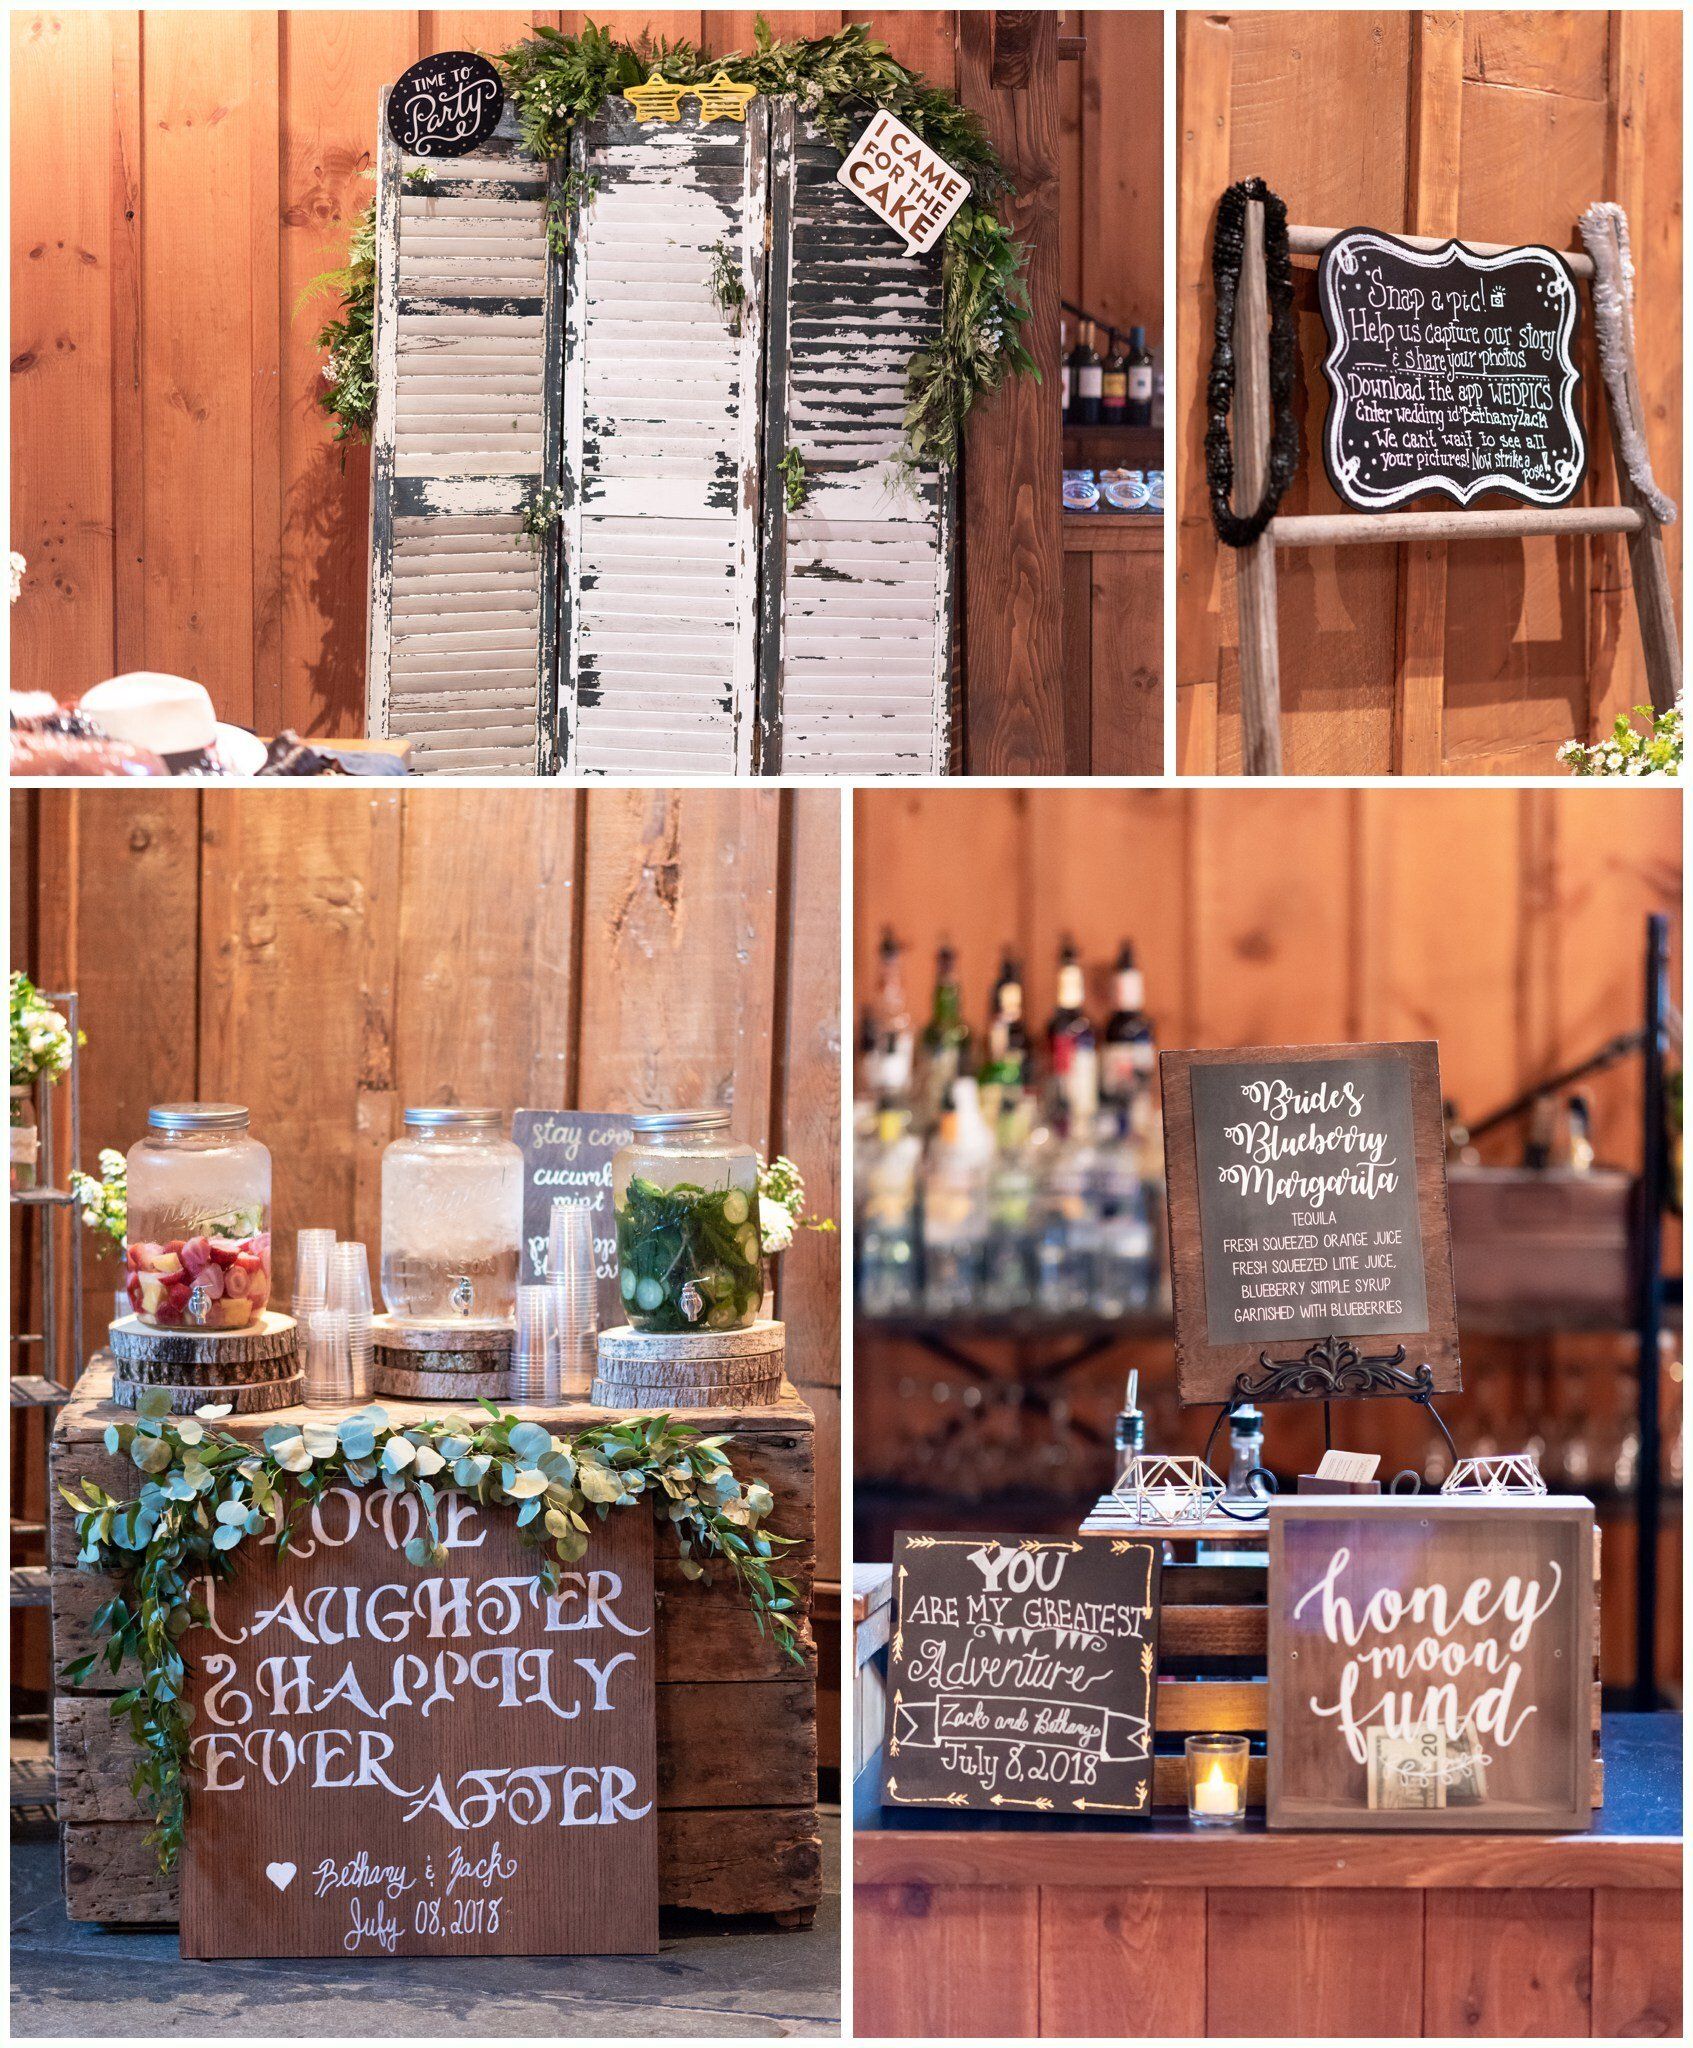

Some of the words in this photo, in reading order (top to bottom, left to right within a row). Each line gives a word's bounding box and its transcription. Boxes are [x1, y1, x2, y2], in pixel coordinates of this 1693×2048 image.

[411, 72, 446, 92] TIME
[450, 66, 473, 82] TO
[404, 79, 497, 155] Party
[862, 140, 905, 184] FOR
[907, 178, 947, 220] THE
[875, 119, 888, 137] I
[891, 133, 962, 202] CAME
[849, 161, 935, 243] CAKE
[1368, 266, 1424, 320] Snap
[1432, 289, 1443, 310] a
[1447, 278, 1487, 321] pic!
[1348, 308, 1395, 351] Help
[1398, 324, 1421, 344] us
[1425, 322, 1480, 350] capture
[1484, 326, 1512, 345] our
[1519, 323, 1556, 360] story
[1405, 346, 1446, 372] share
[1447, 350, 1477, 382] your
[1479, 347, 1527, 374] photos
[1348, 373, 1424, 401] Download
[1429, 380, 1454, 401] the
[1459, 384, 1483, 407] app
[1488, 383, 1553, 410] WEDPICS
[1356, 400, 1392, 424] Enter
[1397, 404, 1444, 431] wedding
[1372, 430, 1398, 448] We
[1403, 431, 1436, 447] can't
[1442, 431, 1473, 447] wait
[1480, 431, 1495, 447] to
[1500, 434, 1521, 448] see
[1527, 434, 1547, 449] all
[1380, 451, 1411, 471] your
[1417, 449, 1470, 470] pictures!
[1472, 447, 1492, 470] Now
[1495, 449, 1523, 468] strike
[1524, 455, 1530, 467] a
[1241, 1079, 1365, 1121] Brides
[532, 1117, 581, 1161] stay
[588, 1128, 633, 1147] coo
[1223, 1121, 1388, 1164] Blueberry
[553, 1192, 604, 1211] mint
[1218, 1157, 1399, 1208] Margarita
[1223, 1238, 1258, 1253] FRESH
[1263, 1235, 1319, 1251] SQUEEZED
[1324, 1232, 1368, 1248] ORANGE
[1373, 1230, 1402, 1245] JUICE
[1291, 1211, 1337, 1226] TEQUILA
[1233, 1260, 1268, 1276] FRESH
[1272, 1257, 1328, 1274] SQUEEZED
[1332, 1256, 1359, 1271] LIME
[1364, 1254, 1397, 1269] JUICE,
[1241, 1282, 1305, 1299] BLUEBERRY
[1311, 1280, 1350, 1295] SIMPLE
[1355, 1277, 1391, 1293] SYRUP
[1234, 1306, 1295, 1323] GARNISHED
[1300, 1303, 1327, 1319] WITH
[1331, 1300, 1403, 1317] BLUEBERRIES
[259, 1487, 487, 1558] LOVE
[966, 1545, 1069, 1594] YOU
[186, 1570, 650, 1646] LAUGHTER
[906, 1595, 959, 1628] ARE
[966, 1595, 1012, 1627] MY
[1023, 1597, 1147, 1639] GREATEST
[1293, 1547, 1562, 1652] honey
[907, 1638, 1114, 1692] Adventure
[1357, 1637, 1510, 1679] moon
[256, 1647, 637, 1719] HAPPILY
[941, 1701, 990, 1729] Zack
[994, 1708, 1028, 1731] and
[1033, 1709, 1101, 1747] Bethany
[1310, 1661, 1538, 1764] fund
[941, 1742, 999, 1790] July
[1421, 1733, 1438, 1757] 20
[190, 1728, 425, 1797] EVER
[403, 1764, 652, 1830] AFTER
[312, 1851, 416, 1899] Bethany
[446, 1841, 517, 1896] Zack
[344, 1897, 405, 1952] July
